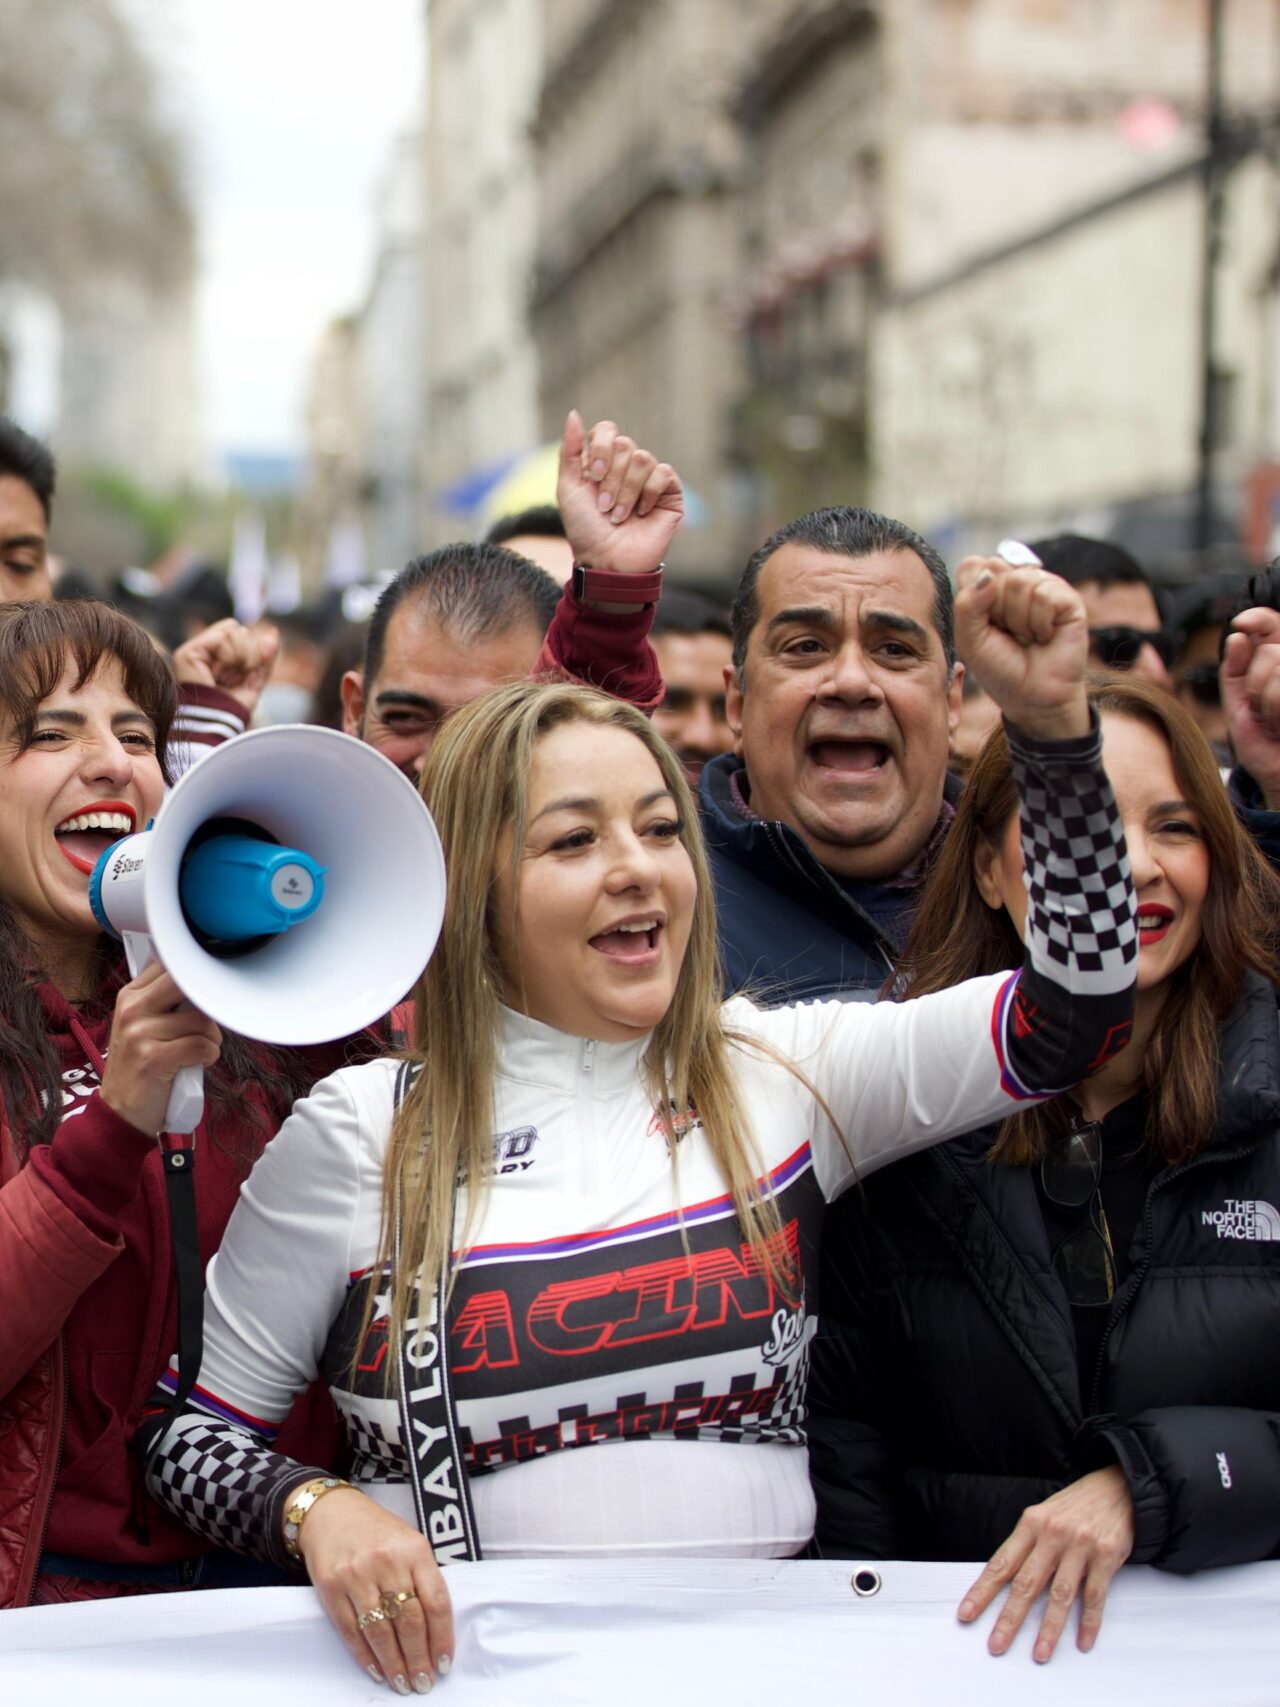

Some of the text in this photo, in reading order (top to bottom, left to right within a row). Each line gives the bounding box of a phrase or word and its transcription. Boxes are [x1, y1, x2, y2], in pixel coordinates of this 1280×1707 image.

[122, 857, 144, 873] Steren
[1224, 1199, 1255, 1213] THE
[1201, 1211, 1255, 1226] NORTH
[1216, 1225, 1256, 1240] FACE
[1215, 1452, 1232, 1489] 700
